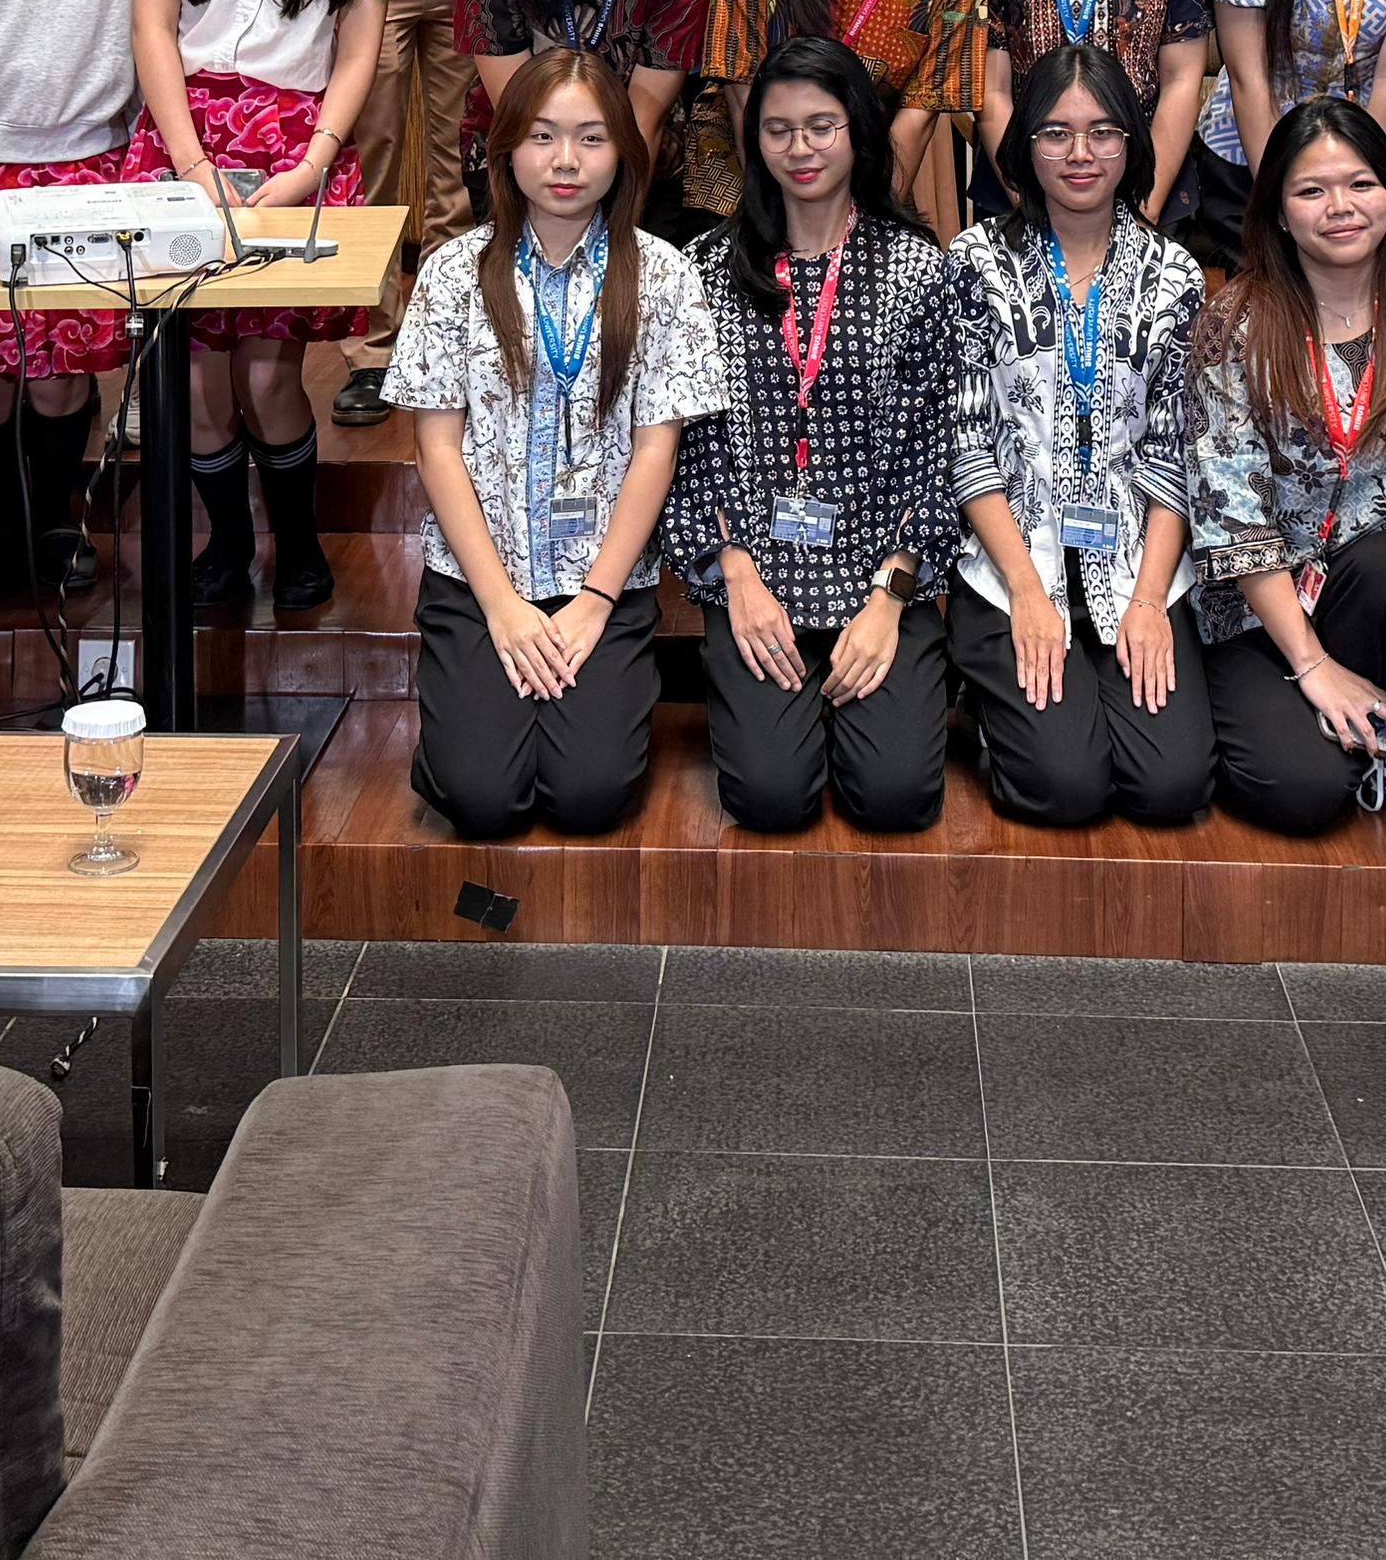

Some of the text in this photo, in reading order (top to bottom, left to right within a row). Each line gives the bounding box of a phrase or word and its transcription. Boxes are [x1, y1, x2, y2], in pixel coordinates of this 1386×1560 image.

[542, 316, 559, 359] UNIVERSITY
[572, 333, 586, 359] BINUS
[1084, 298, 1095, 366] BINUS UNIVERSITY
